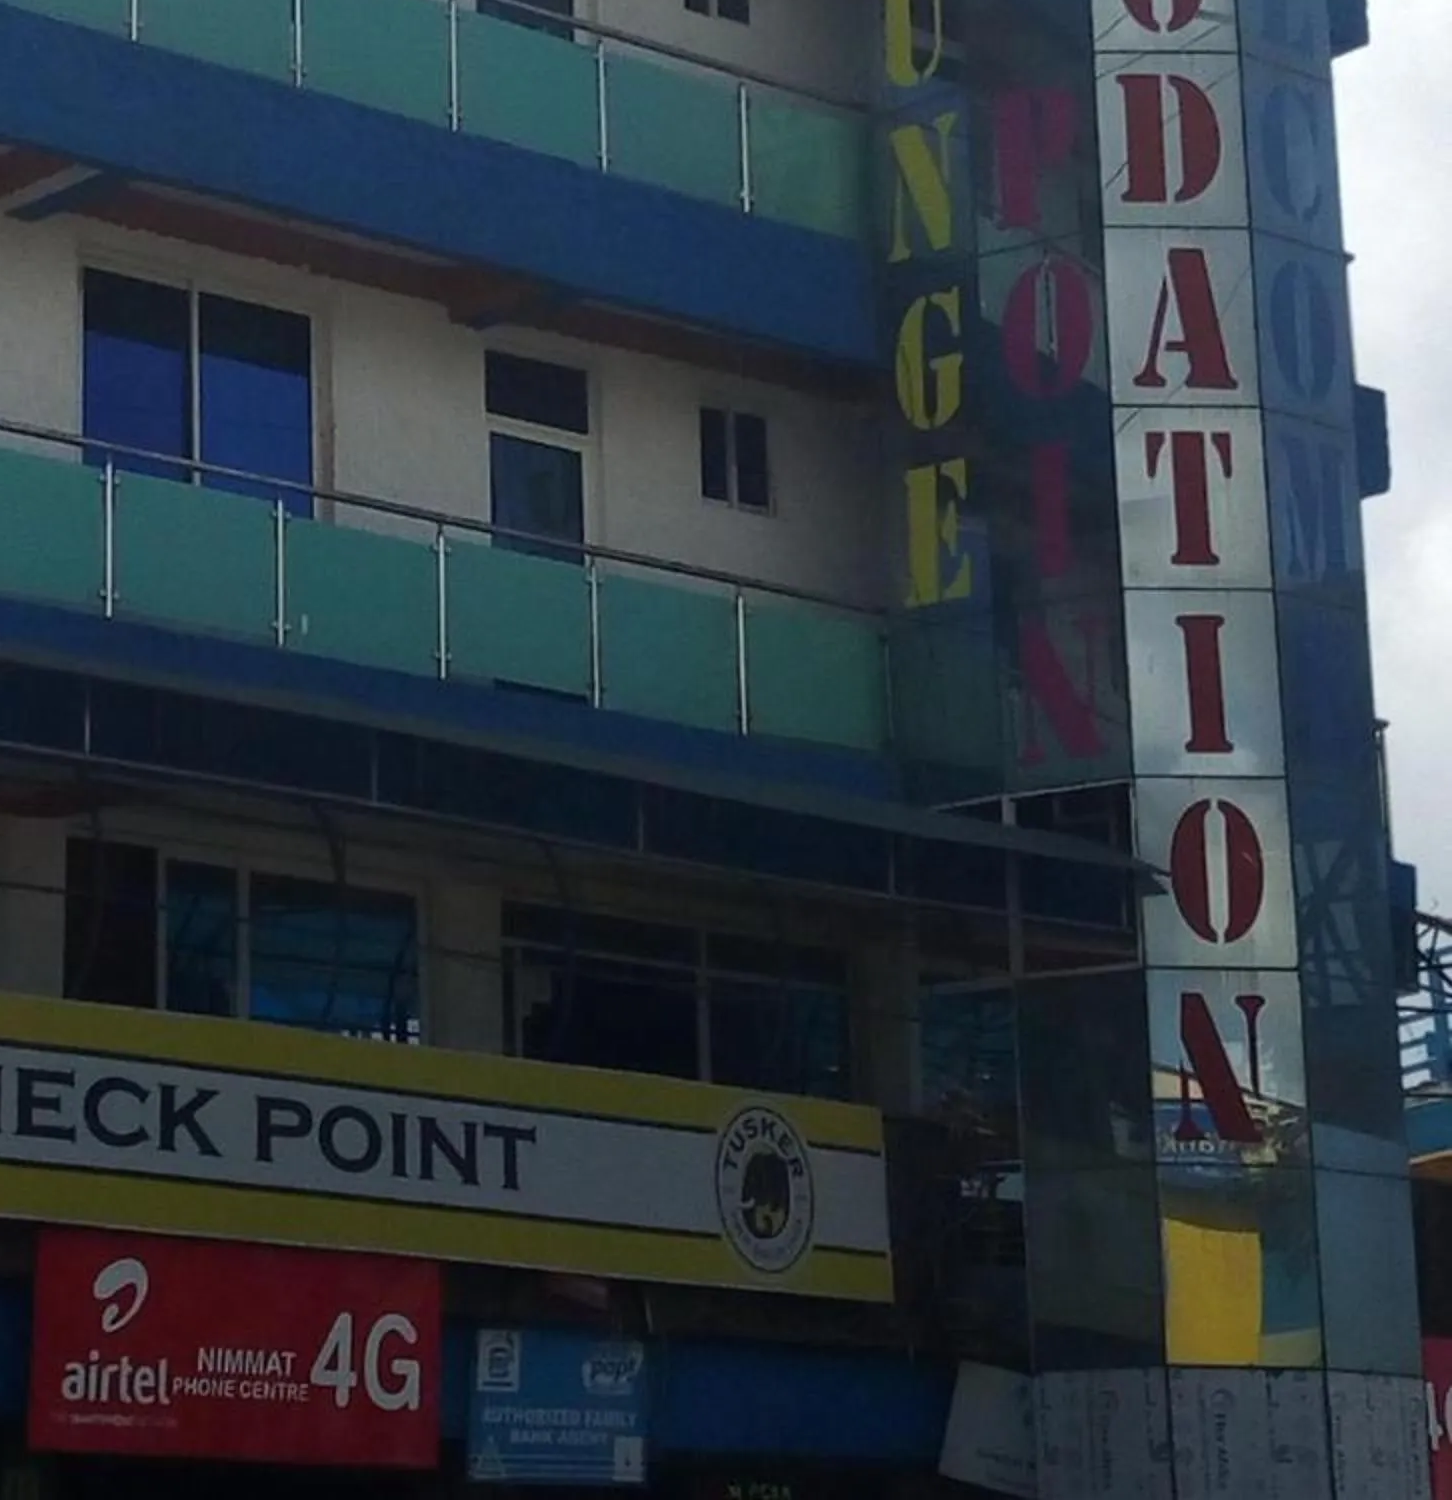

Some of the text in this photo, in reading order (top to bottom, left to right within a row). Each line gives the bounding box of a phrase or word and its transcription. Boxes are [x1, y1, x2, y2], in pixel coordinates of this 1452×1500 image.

[252, 1098, 538, 1193] POINT
[722, 1116, 804, 1178] TUSKER
[60, 1349, 171, 1405] airtel
[171, 1377, 310, 1402] PHONE CENTRE
[197, 1346, 298, 1378] NIMMAT
[309, 1311, 422, 1411] 4G
